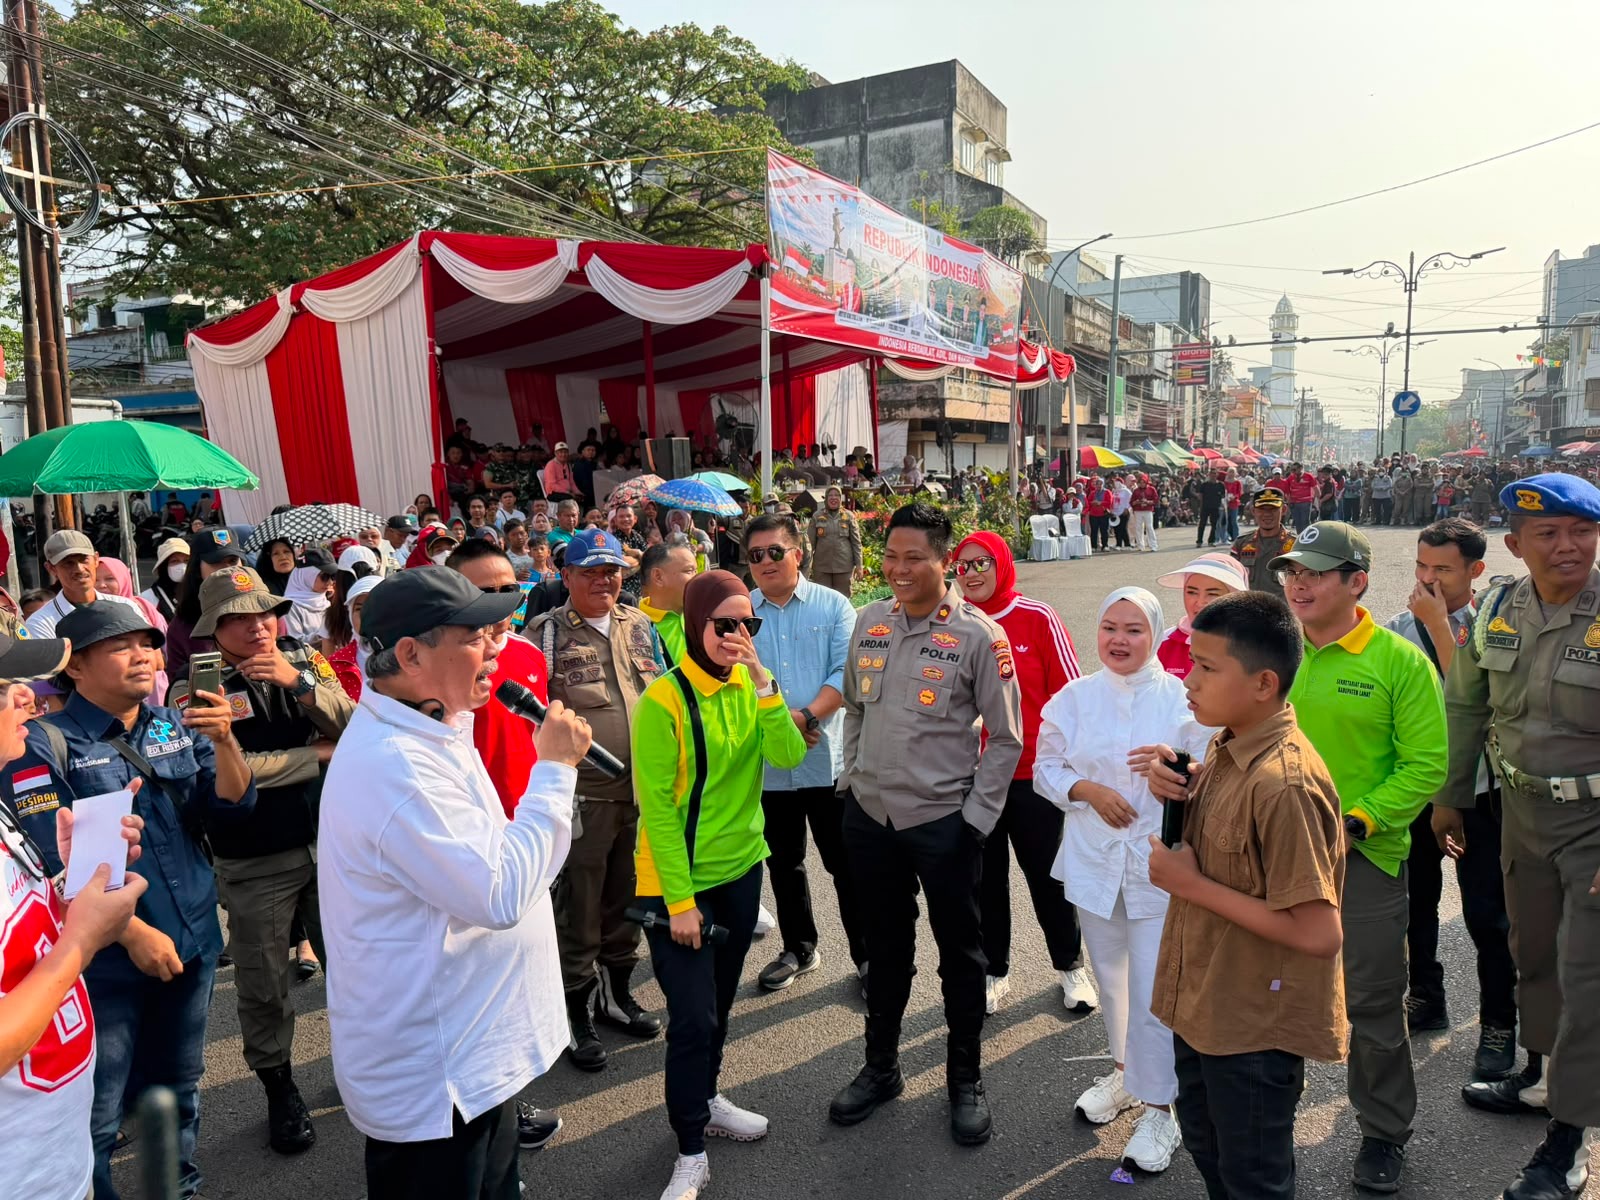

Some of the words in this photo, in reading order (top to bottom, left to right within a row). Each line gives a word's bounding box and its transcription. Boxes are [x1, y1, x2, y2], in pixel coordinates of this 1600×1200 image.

[863, 222, 919, 266] REPUBLIK
[921, 250, 981, 285] INDONESIA
[878, 335, 907, 352] INDONESIA
[858, 639, 891, 649] ARDAN
[919, 647, 961, 663] POLRI
[1336, 678, 1360, 688] SEKRETARIAT
[1360, 682, 1375, 690] DAERAH
[1337, 687, 1359, 696] KABUPATEN
[16, 791, 59, 810] PESIRAH
